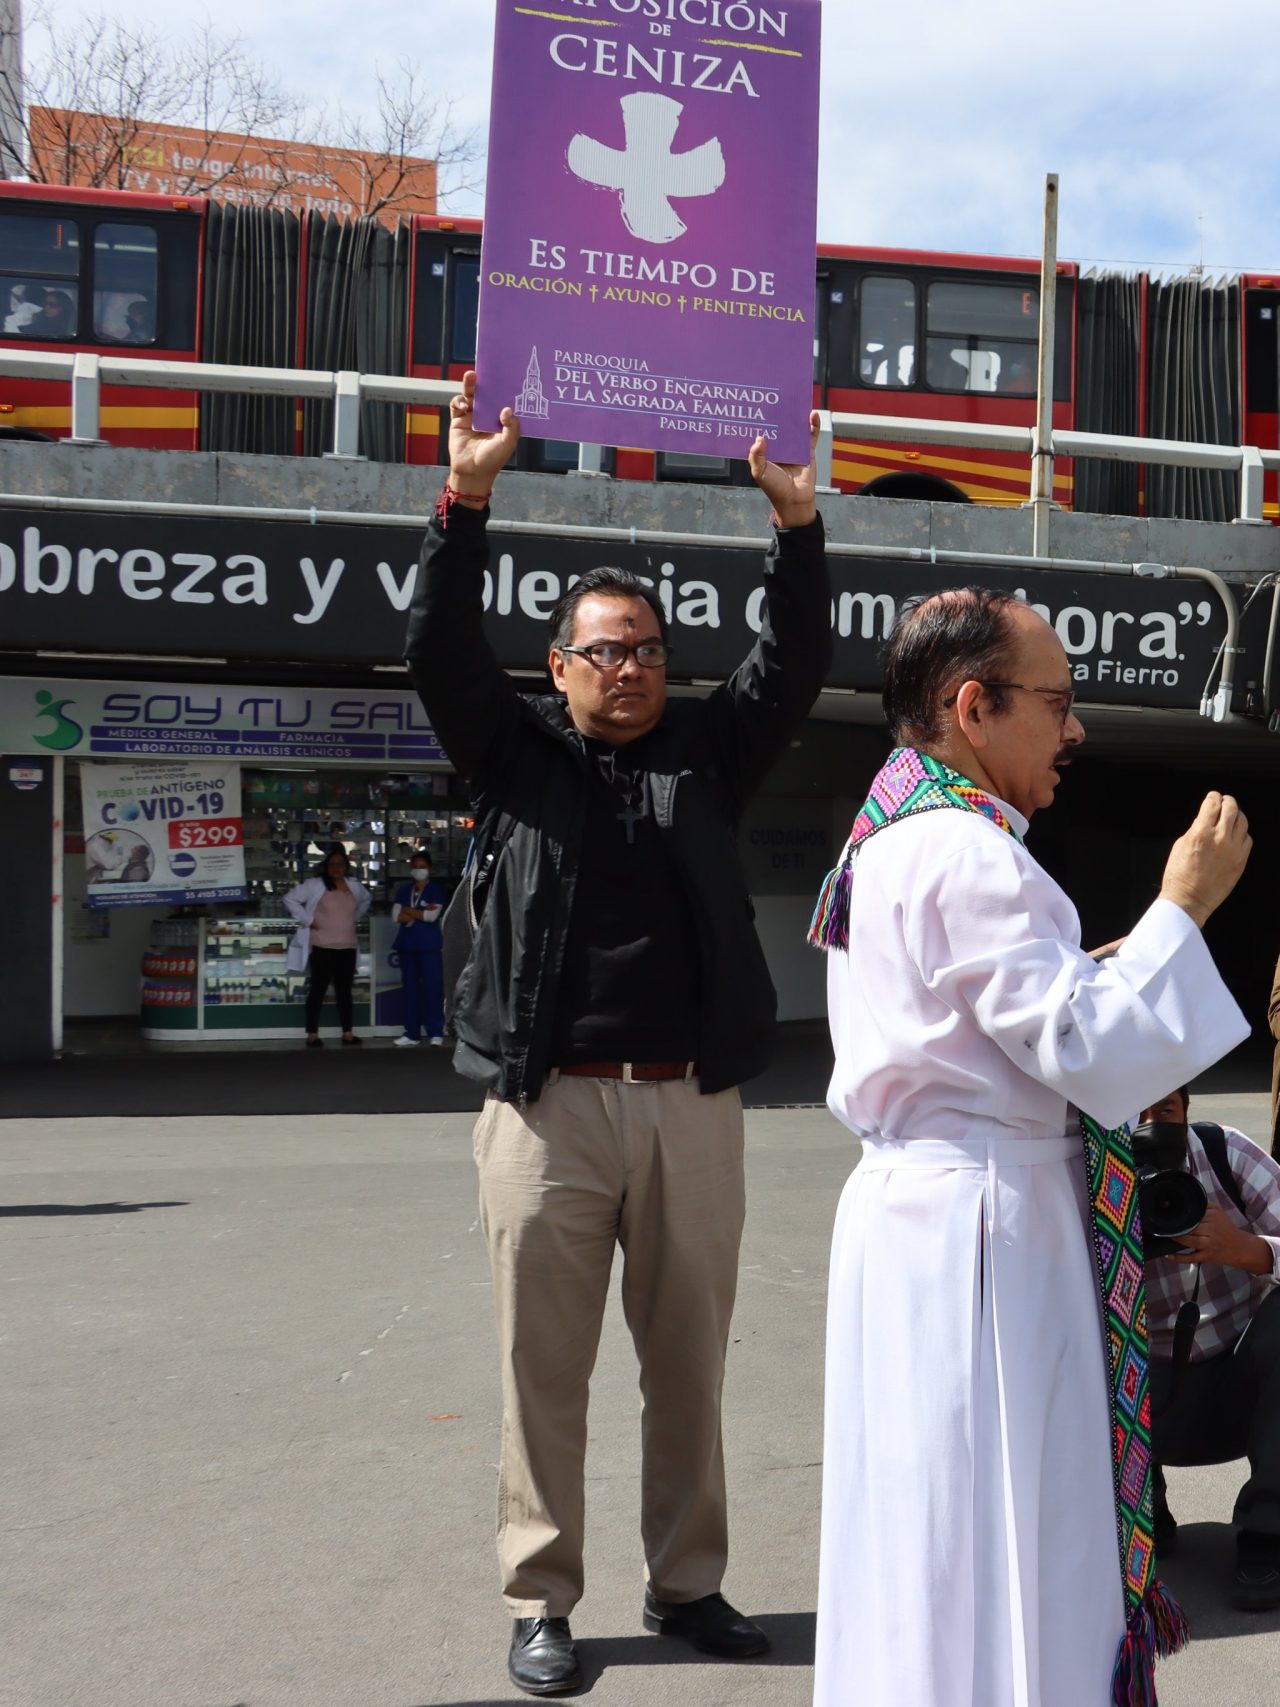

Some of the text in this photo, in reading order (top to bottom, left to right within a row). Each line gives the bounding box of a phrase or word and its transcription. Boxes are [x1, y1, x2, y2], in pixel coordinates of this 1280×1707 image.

[648, 21, 672, 37] DE
[549, 33, 760, 98] CENIZA
[580, 249, 717, 288] TIEMPO
[731, 268, 775, 296] DE
[488, 271, 806, 323] ORACIÓN AYUNO PENITENCIA
[554, 349, 650, 373] PARROQUIA
[555, 386, 568, 399] Y
[0, 526, 268, 605] breza
[293, 557, 345, 624] y
[1097, 659, 1179, 686] Fierro
[102, 693, 434, 731] SOY TU SAL
[108, 728, 218, 741] MÉDICO GENERAL
[279, 733, 345, 743] FARMACIA
[125, 743, 351, 757] LABORATORIO DE ANÁLISIS CLÍNICOS
[136, 787, 149, 797] DE
[150, 779, 226, 796] ANTÍGENO
[178, 825, 238, 848] $299
